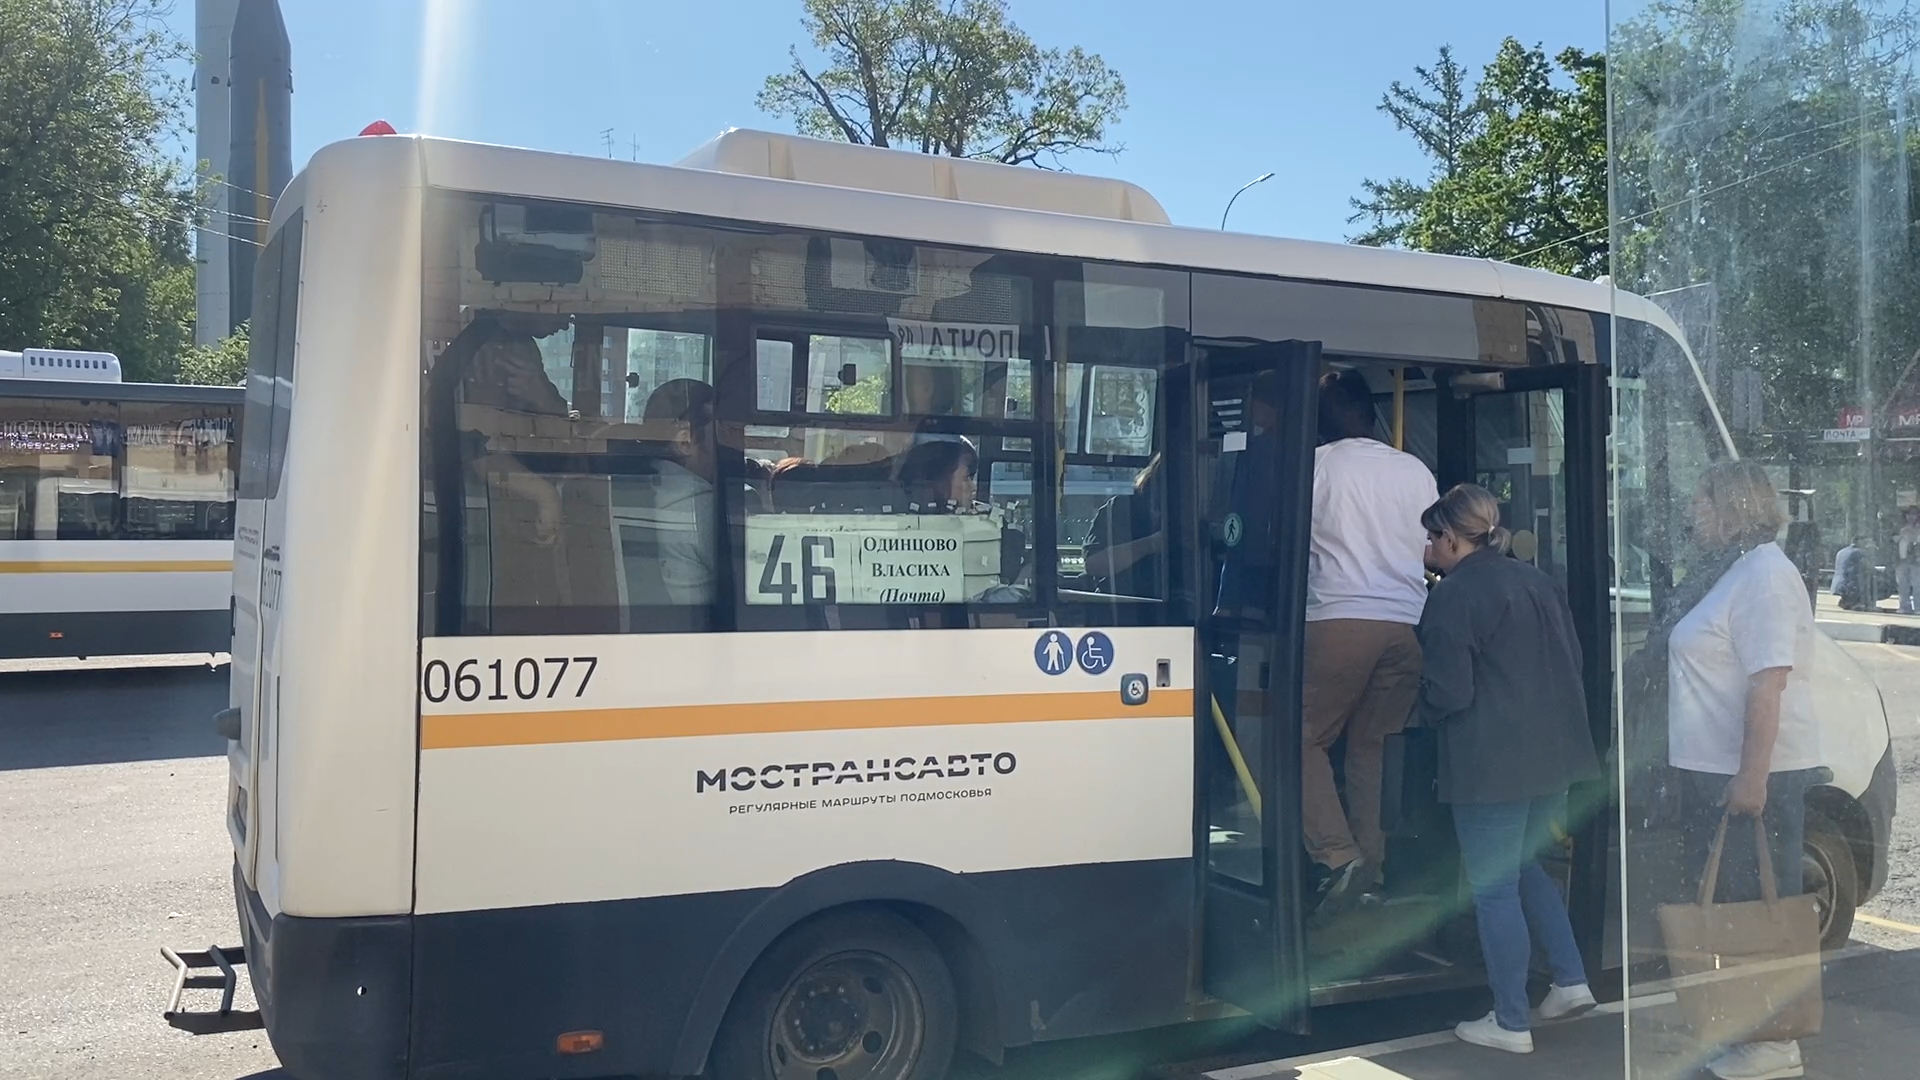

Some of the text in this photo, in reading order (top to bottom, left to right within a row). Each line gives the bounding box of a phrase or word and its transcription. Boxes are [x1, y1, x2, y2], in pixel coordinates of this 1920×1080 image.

[1825, 430, 1857, 439] ПОЧТА
[863, 536, 957, 552] ОДИНЦОВО
[758, 534, 837, 605] 46
[871, 562, 951, 578] ВЛАСИХА
[879, 587, 946, 603] (Почта)
[423, 656, 598, 703] 061077
[696, 751, 1017, 793] МОСТРАНСАВТО
[729, 788, 992, 815] РЕГУЛЯРНЫЕ МАРШРУТЫ ПОДМОСКОВЬЯ
